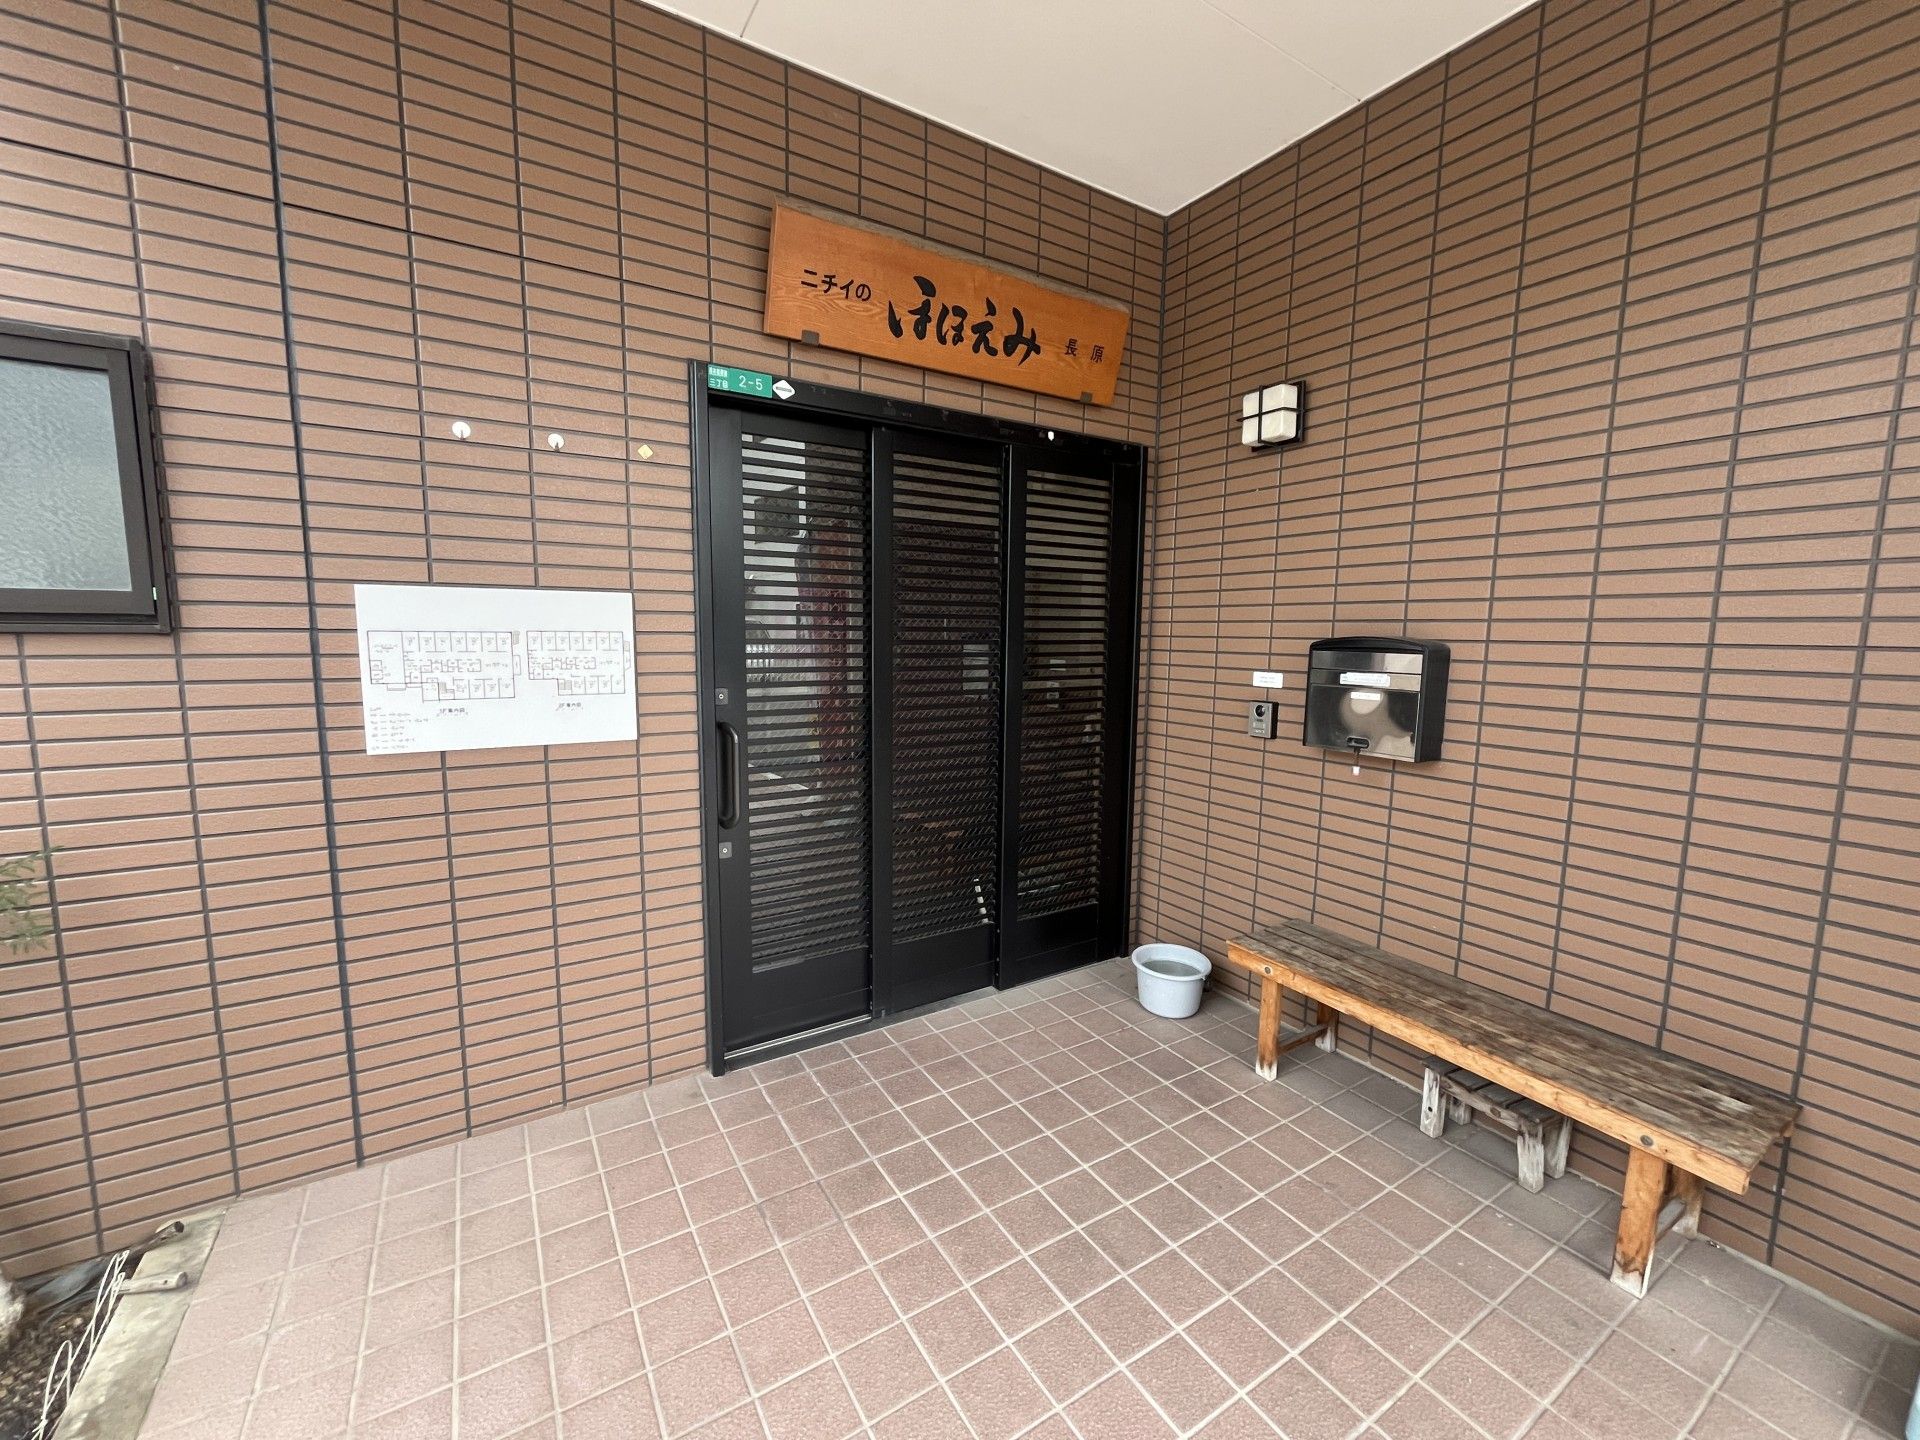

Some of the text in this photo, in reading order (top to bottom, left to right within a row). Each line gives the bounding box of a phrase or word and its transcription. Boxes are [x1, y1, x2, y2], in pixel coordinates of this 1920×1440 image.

[801, 268, 872, 302] ニチイの
[888, 275, 1041, 366] ほほえみ
[738, 374, 763, 391] 2-5
